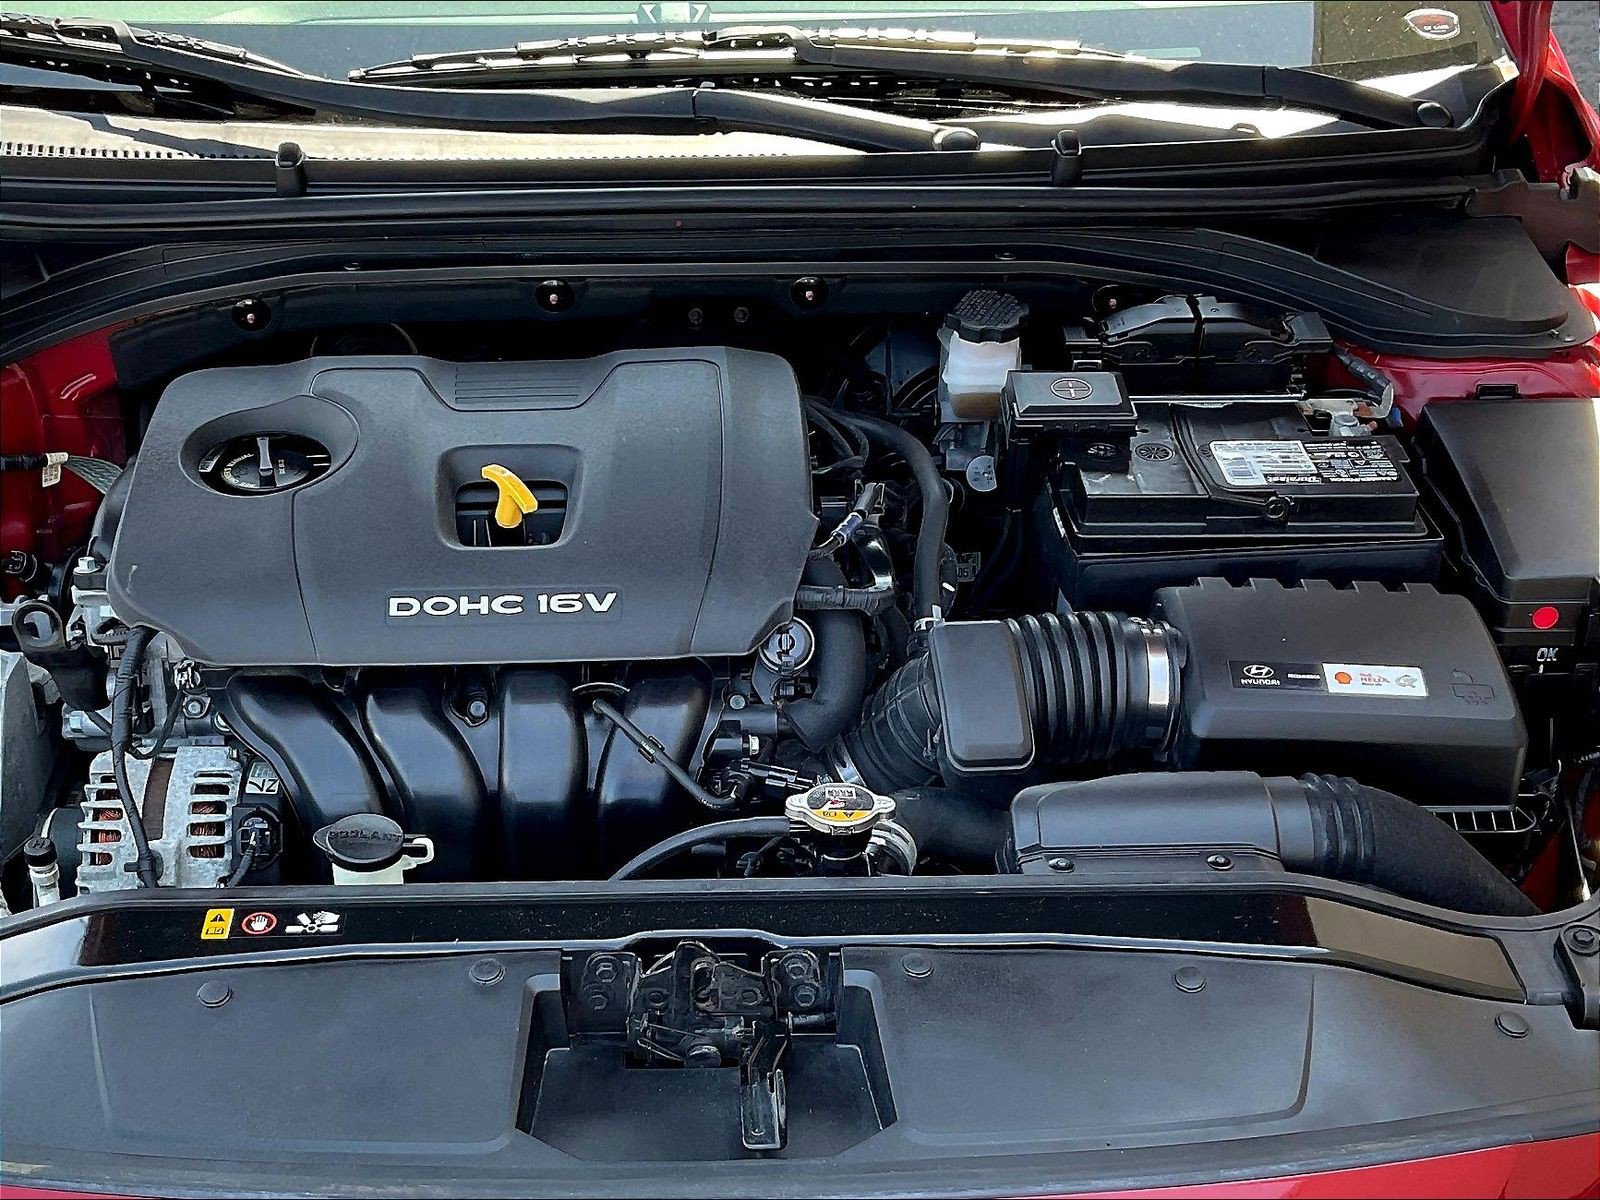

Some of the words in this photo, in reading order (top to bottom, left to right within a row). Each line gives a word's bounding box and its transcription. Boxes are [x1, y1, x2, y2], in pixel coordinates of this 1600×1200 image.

[389, 595, 524, 617] DOHC
[537, 592, 617, 613] 16V
[1536, 647, 1559, 662] OK
[1240, 678, 1281, 686] HYUNDAI
[328, 829, 403, 843] COOLANT
